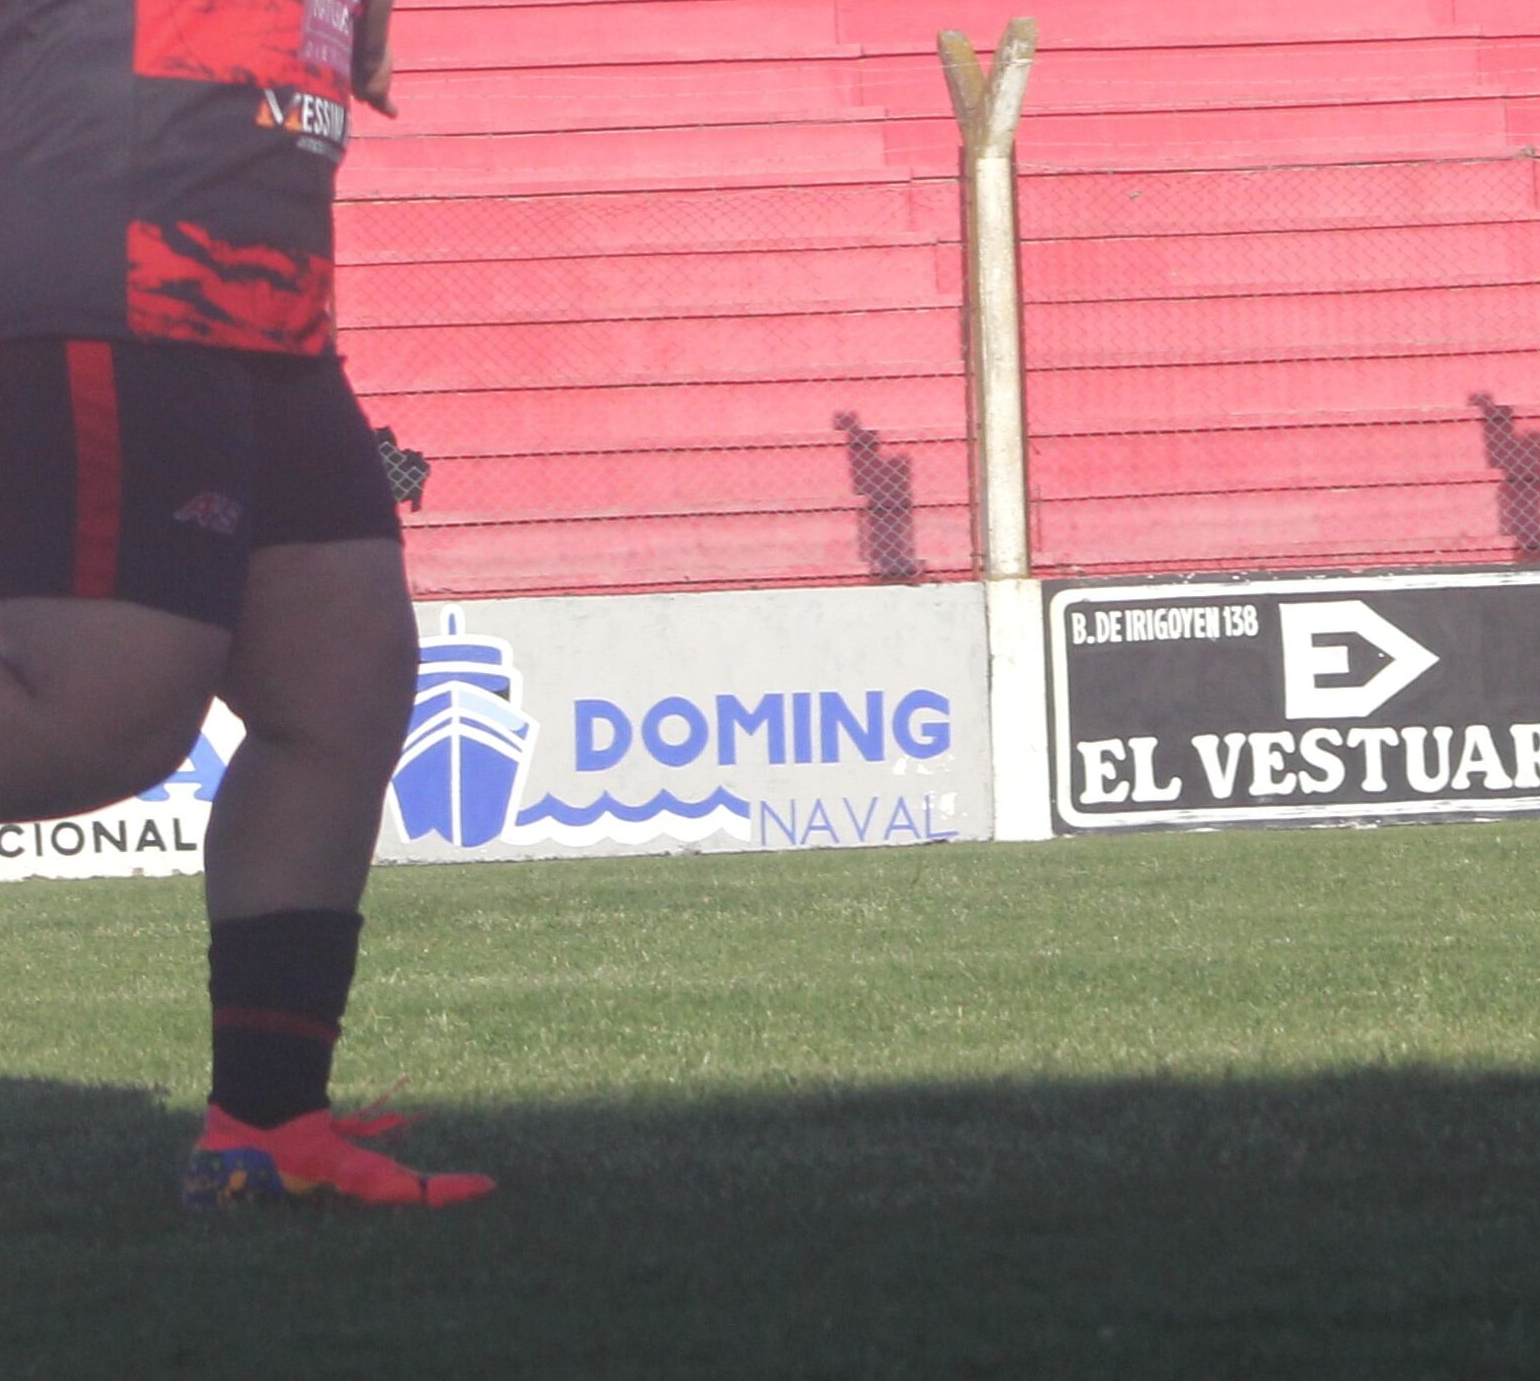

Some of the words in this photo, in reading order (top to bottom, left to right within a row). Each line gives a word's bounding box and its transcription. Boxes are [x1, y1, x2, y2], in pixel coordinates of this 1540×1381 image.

[1124, 606, 1221, 642] IRIGOYEN
[1222, 604, 1259, 637] 138
[573, 688, 952, 772] DOMING
[1076, 736, 1182, 805] EL
[760, 795, 960, 846] NAVAL
